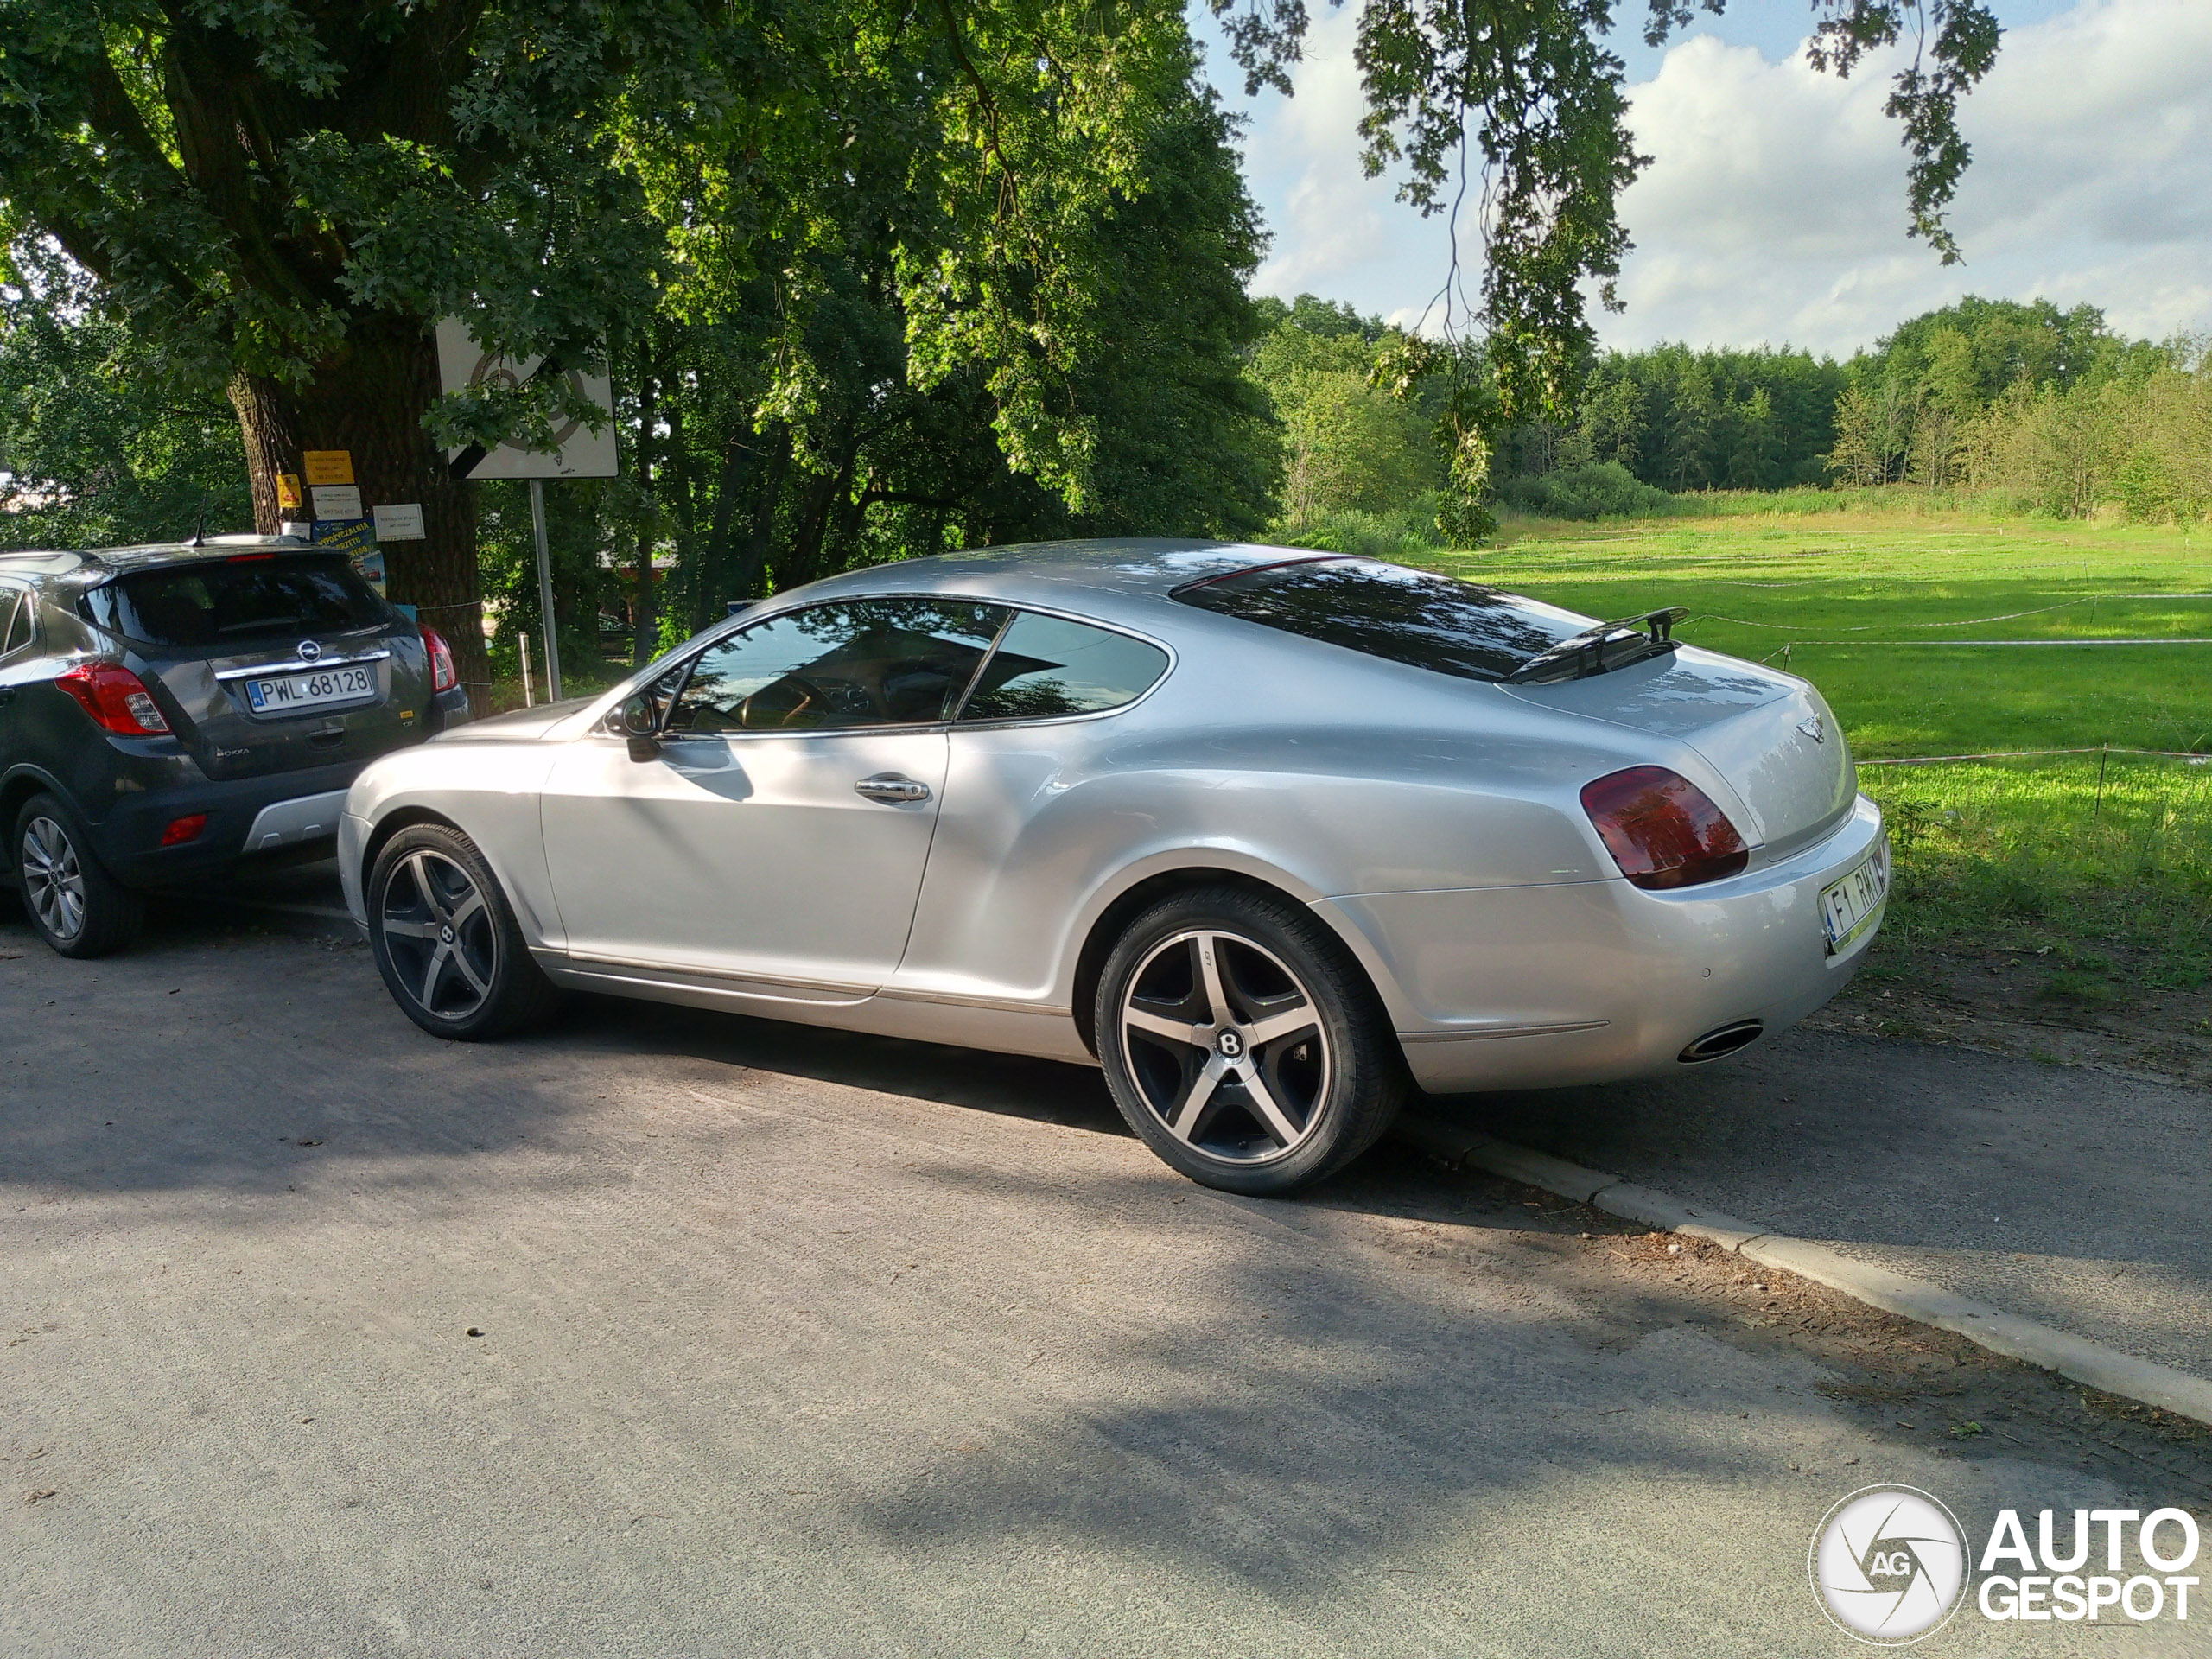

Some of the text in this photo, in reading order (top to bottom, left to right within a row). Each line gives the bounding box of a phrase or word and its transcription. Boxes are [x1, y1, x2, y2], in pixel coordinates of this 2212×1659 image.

[260, 671, 368, 704] PWL 68128
[1831, 884, 1856, 931] F1
[1204, 950, 1212, 969] GT
[1219, 1033, 1240, 1055] B
